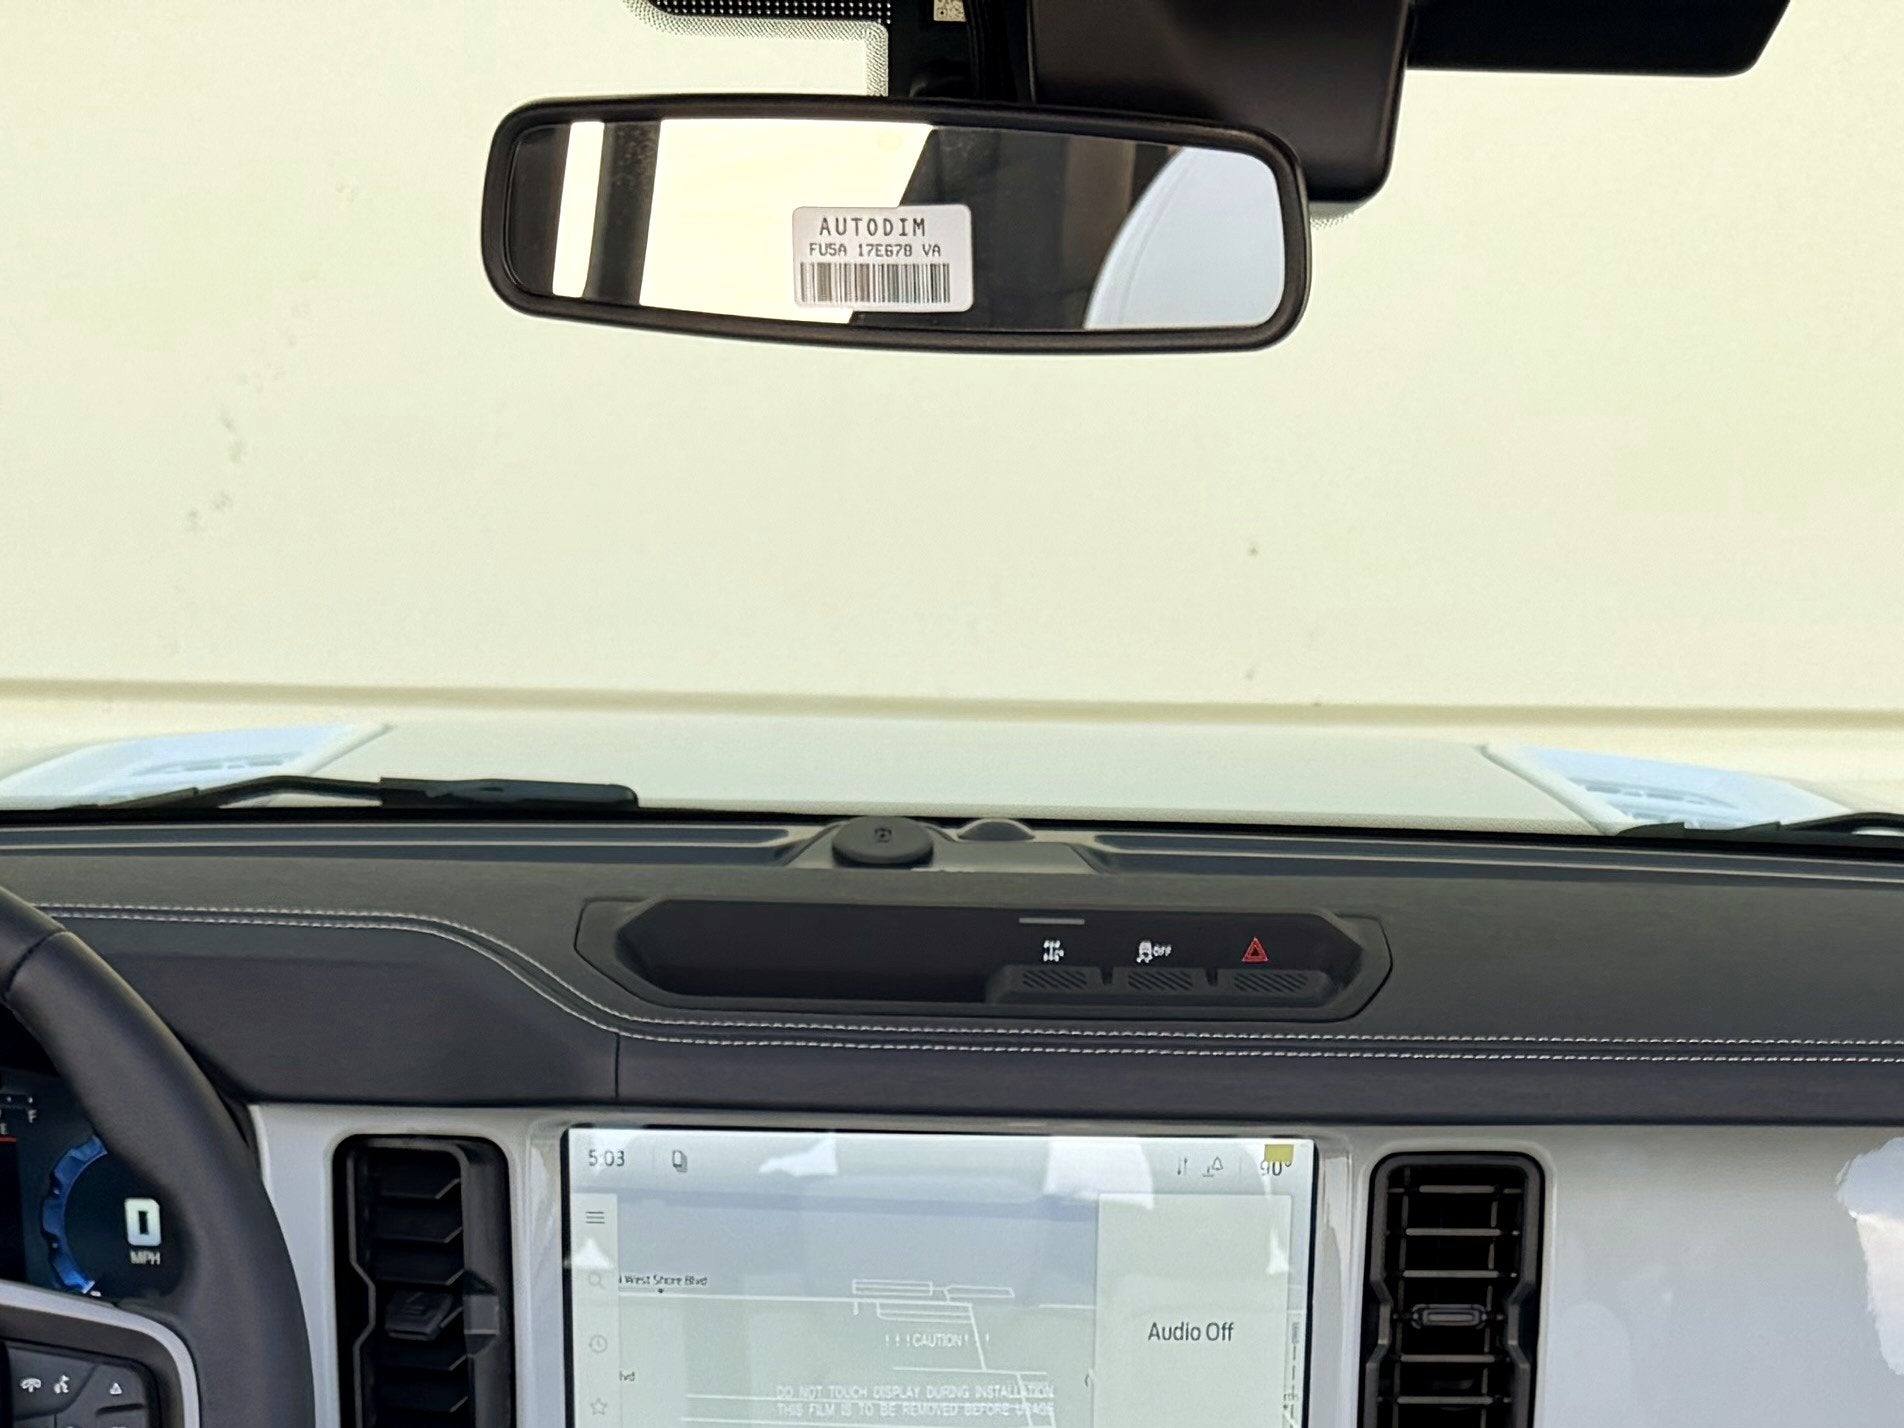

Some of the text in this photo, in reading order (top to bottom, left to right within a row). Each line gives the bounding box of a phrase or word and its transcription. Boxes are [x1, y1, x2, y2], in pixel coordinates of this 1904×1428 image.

[819, 217, 926, 237] AUTODIM
[922, 244, 941, 257] VA
[28, 1109, 36, 1123] F
[124, 1198, 162, 1247] 0
[130, 1250, 161, 1265] MPH
[653, 1274, 683, 1286] Shore
[685, 1274, 708, 1286] Blvd
[1148, 1321, 1235, 1342] Audio Off
[776, 1385, 970, 1400] DO NOT TOUCH DISPLAY DURING
[776, 1402, 804, 1416] THIS
[809, 1402, 835, 1416] FILM
[859, 1403, 874, 1416] TO
[880, 1403, 896, 1416] BE
[902, 1403, 958, 1416] REMOVED
